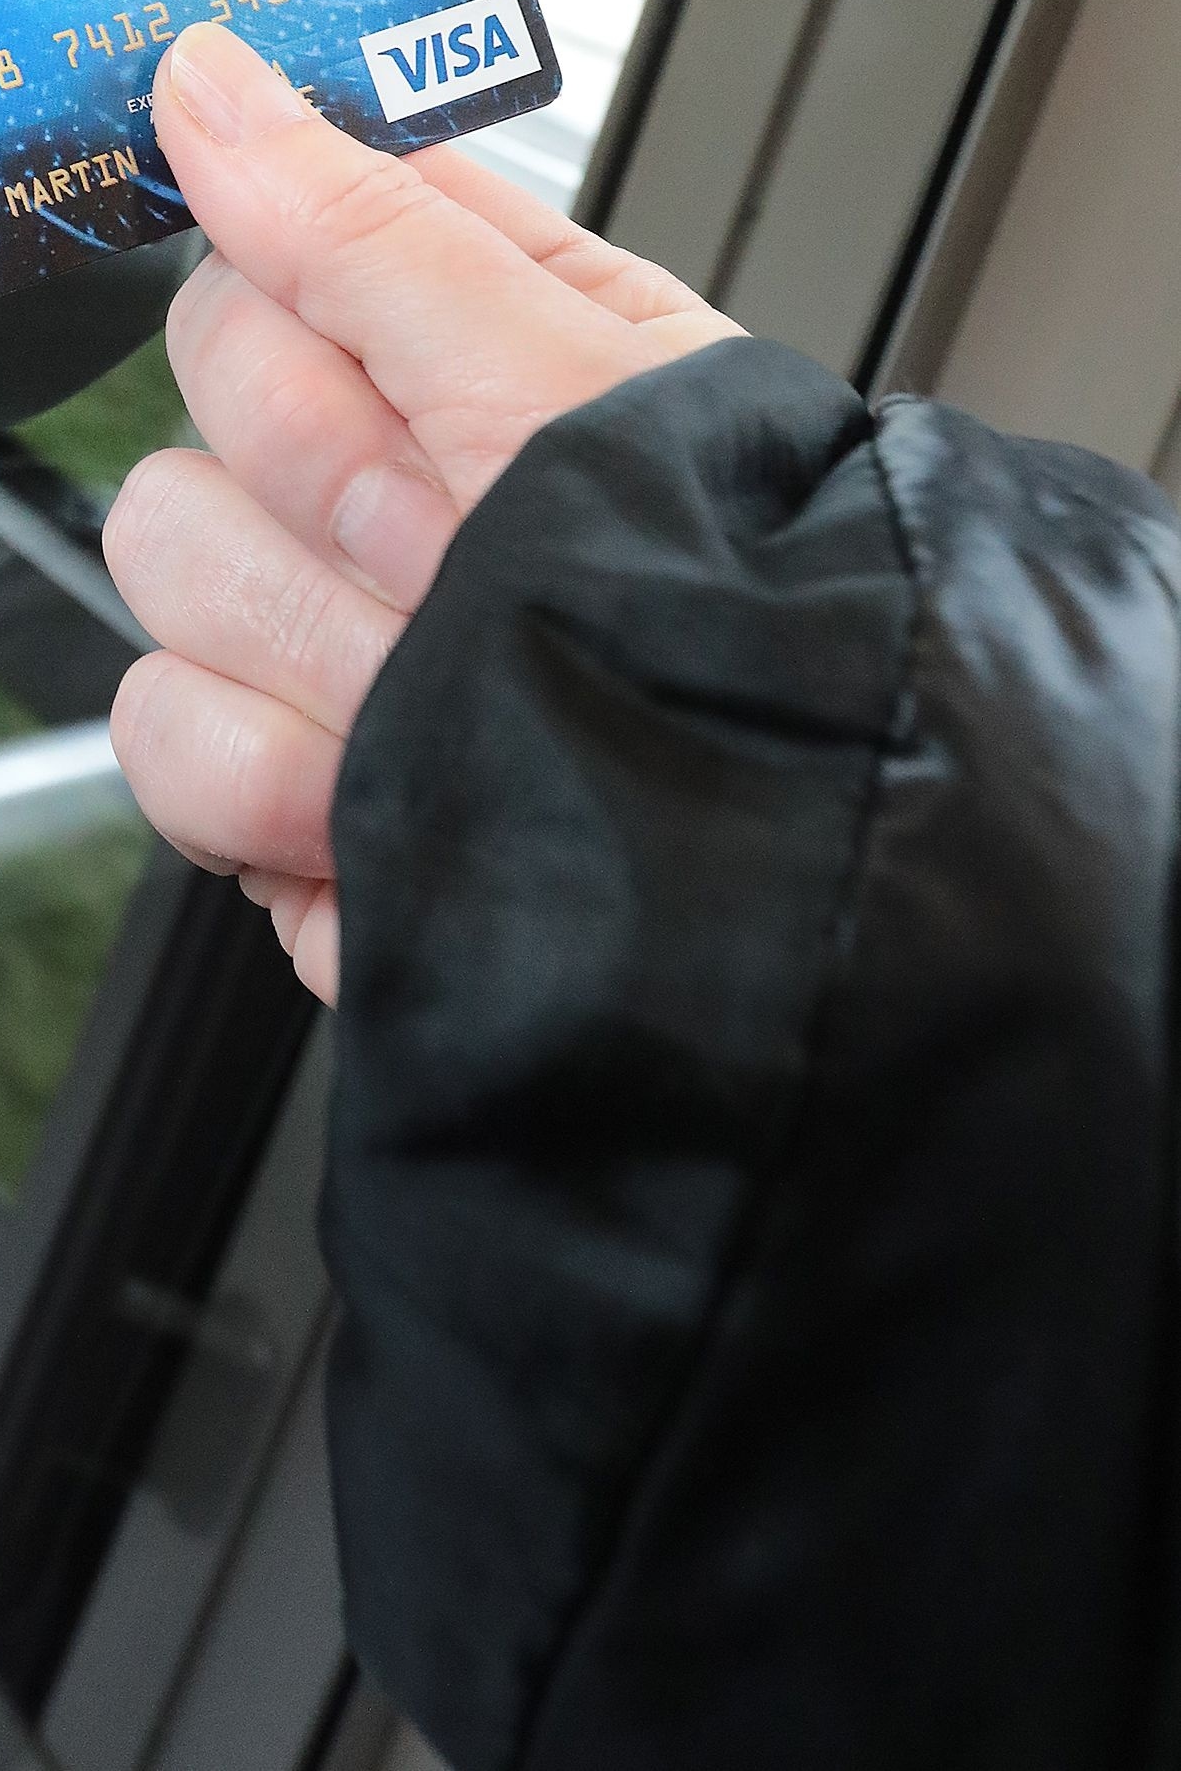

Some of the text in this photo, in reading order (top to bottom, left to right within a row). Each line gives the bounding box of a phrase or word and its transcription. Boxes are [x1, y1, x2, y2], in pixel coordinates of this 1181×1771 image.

[52, 1, 176, 69] 7412
[377, 14, 519, 94] VISA
[3, 145, 140, 218] MARTIN
